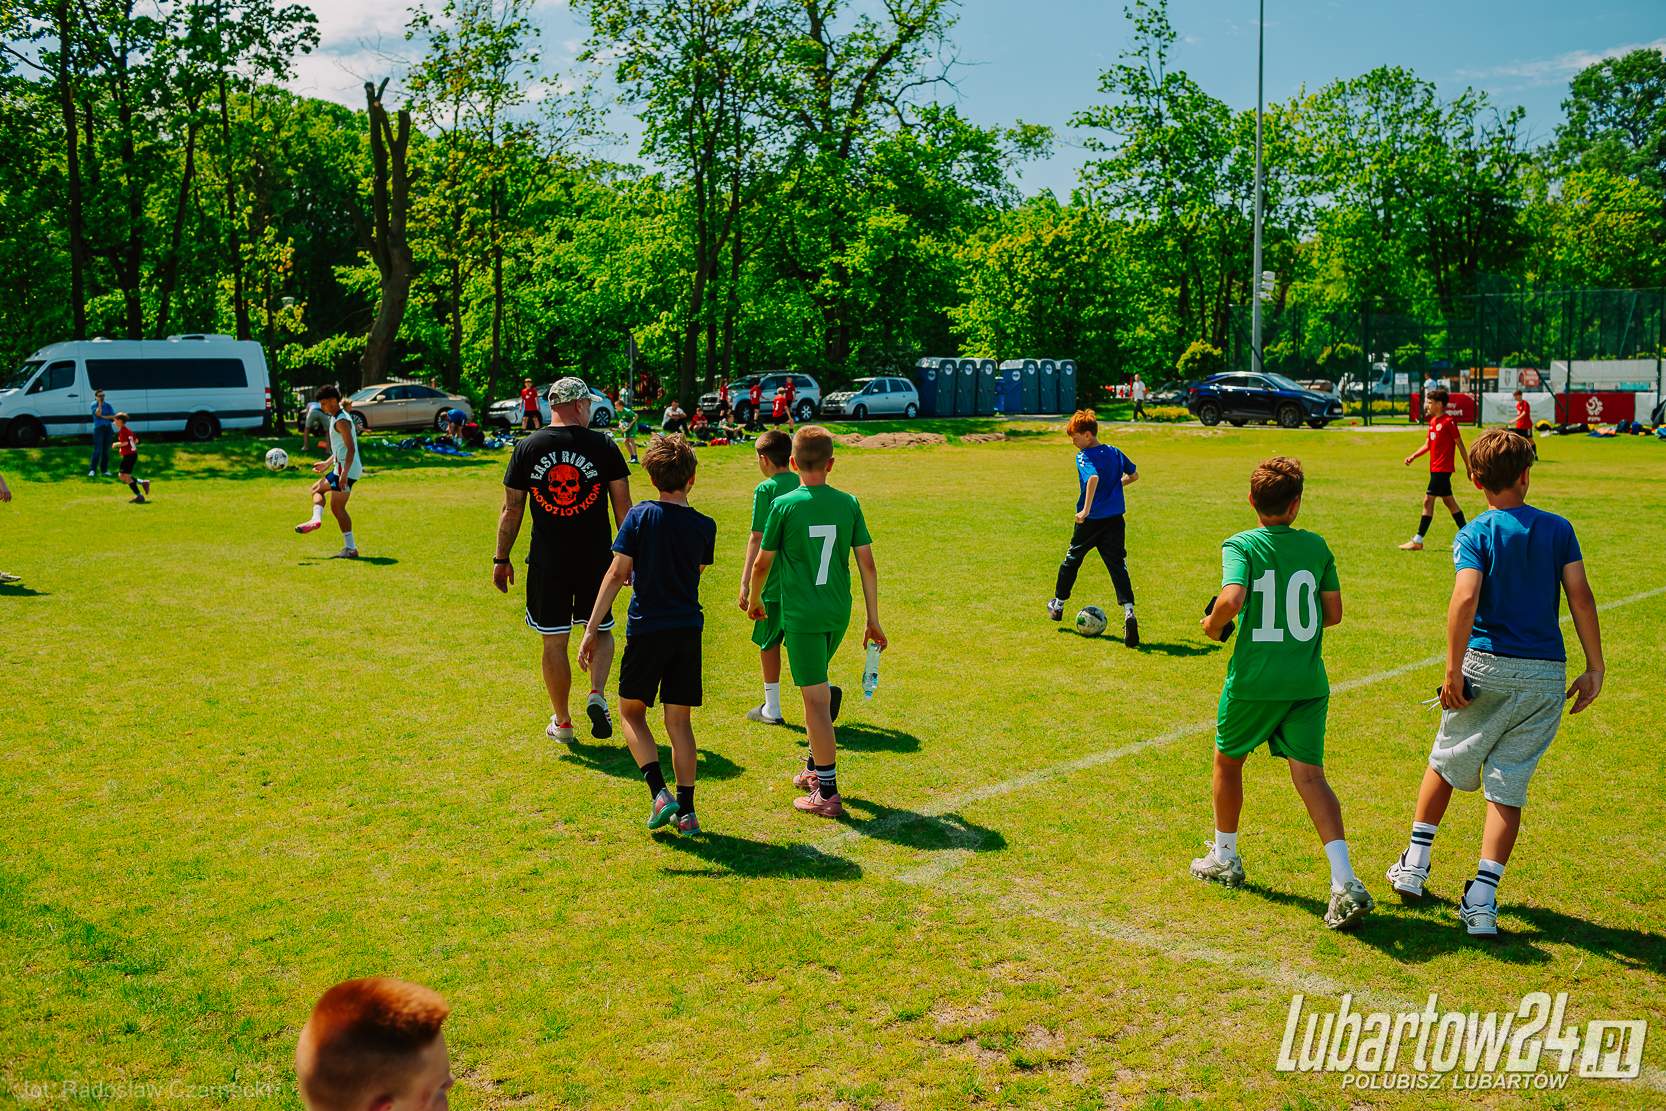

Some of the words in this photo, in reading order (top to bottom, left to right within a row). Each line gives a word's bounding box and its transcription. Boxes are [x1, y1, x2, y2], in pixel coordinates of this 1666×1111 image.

[530, 451, 558, 480] EASY
[561, 450, 599, 479] RIDER
[530, 483, 601, 517] MOTOZLOTY.COM
[808, 524, 837, 586] 7
[1251, 569, 1318, 642] 10
